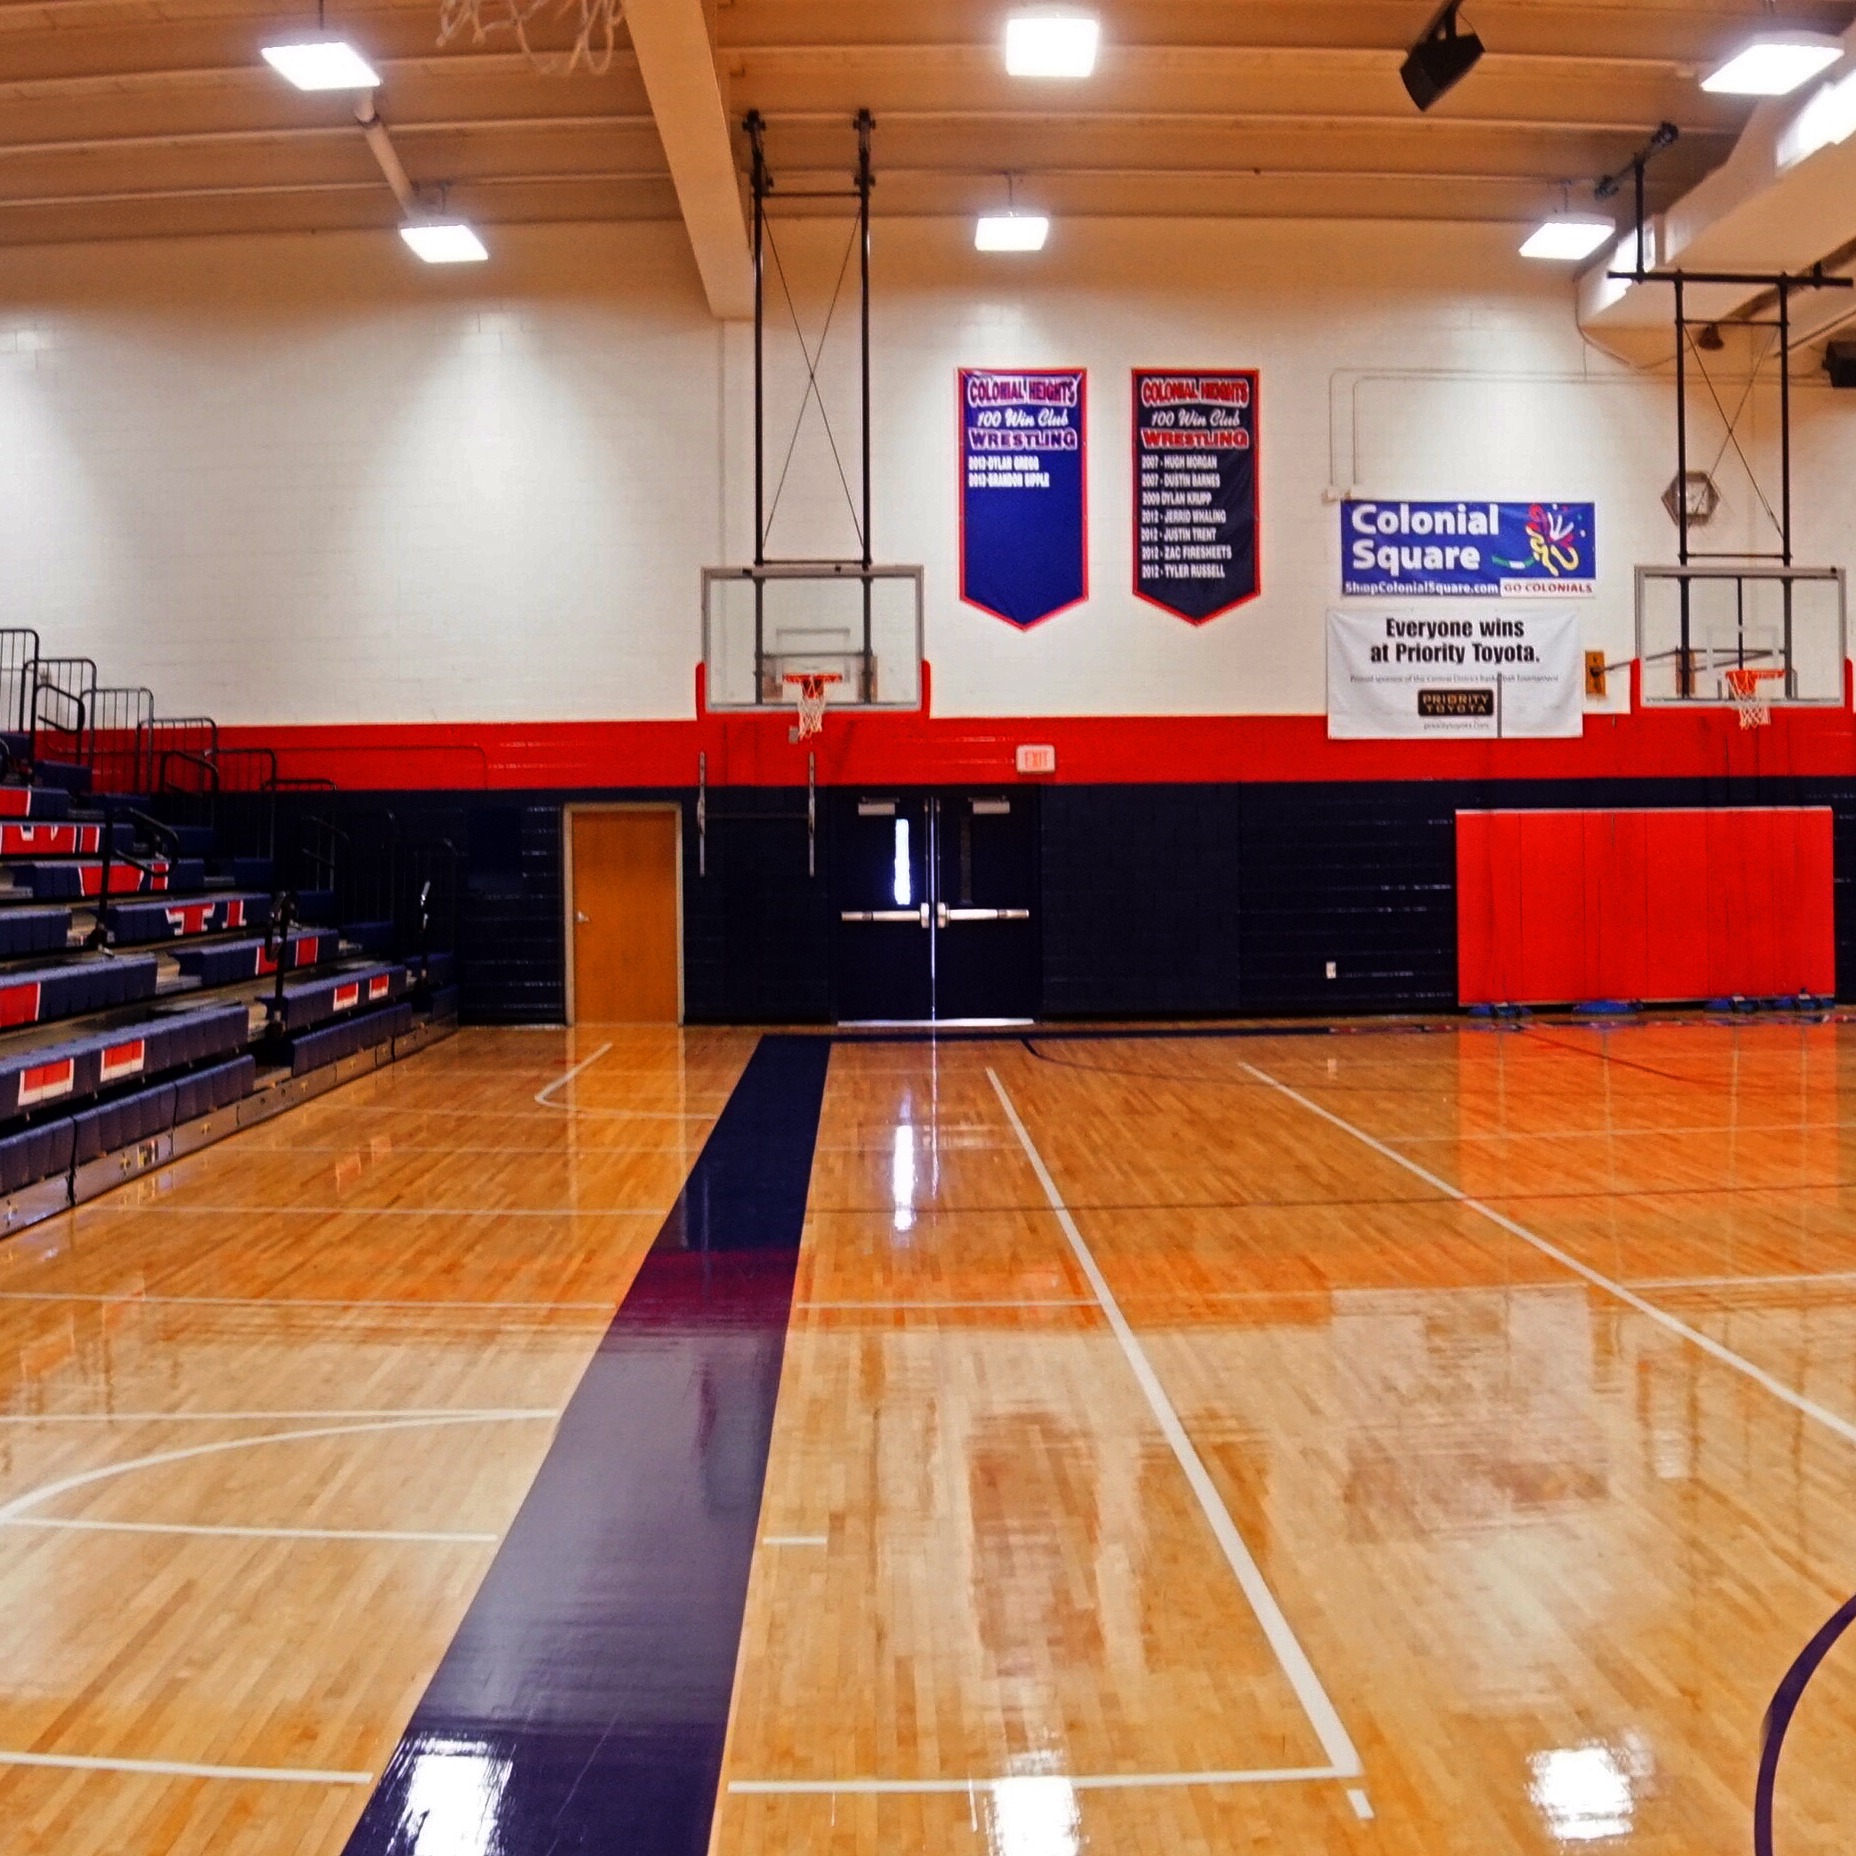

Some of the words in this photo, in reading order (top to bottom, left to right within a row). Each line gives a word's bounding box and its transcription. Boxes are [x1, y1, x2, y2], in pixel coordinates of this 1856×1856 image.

[968, 376, 1025, 407] COLONIAL
[1027, 376, 1077, 407] HEIGHTS
[1141, 377, 1197, 407] COLONIAL
[1199, 377, 1249, 407] HEIGHTS
[978, 410, 1002, 427] 100
[1005, 408, 1035, 427] Win
[1038, 408, 1069, 427] Club
[1151, 410, 1175, 427] 100
[1178, 408, 1207, 427] Win
[1210, 408, 1240, 427] Club
[968, 427, 1077, 450] WRESTLING
[1141, 427, 1249, 450] WRESTLING
[1352, 503, 1499, 536] Colonial
[1352, 538, 1481, 577] Square
[1345, 581, 1498, 595] ShopColonialSquare.com
[1504, 584, 1522, 593] GO
[1525, 584, 1593, 593] COLONIALS
[1386, 618, 1473, 639] Everyone
[1479, 618, 1524, 637] wins
[1370, 644, 1389, 663] at
[1395, 643, 1465, 664] Priority
[1472, 643, 1540, 664] Toyota.
[1422, 694, 1489, 704] PRIORITY
[1425, 705, 1486, 713] TOYOTA
[1024, 751, 1047, 767] EXIT
